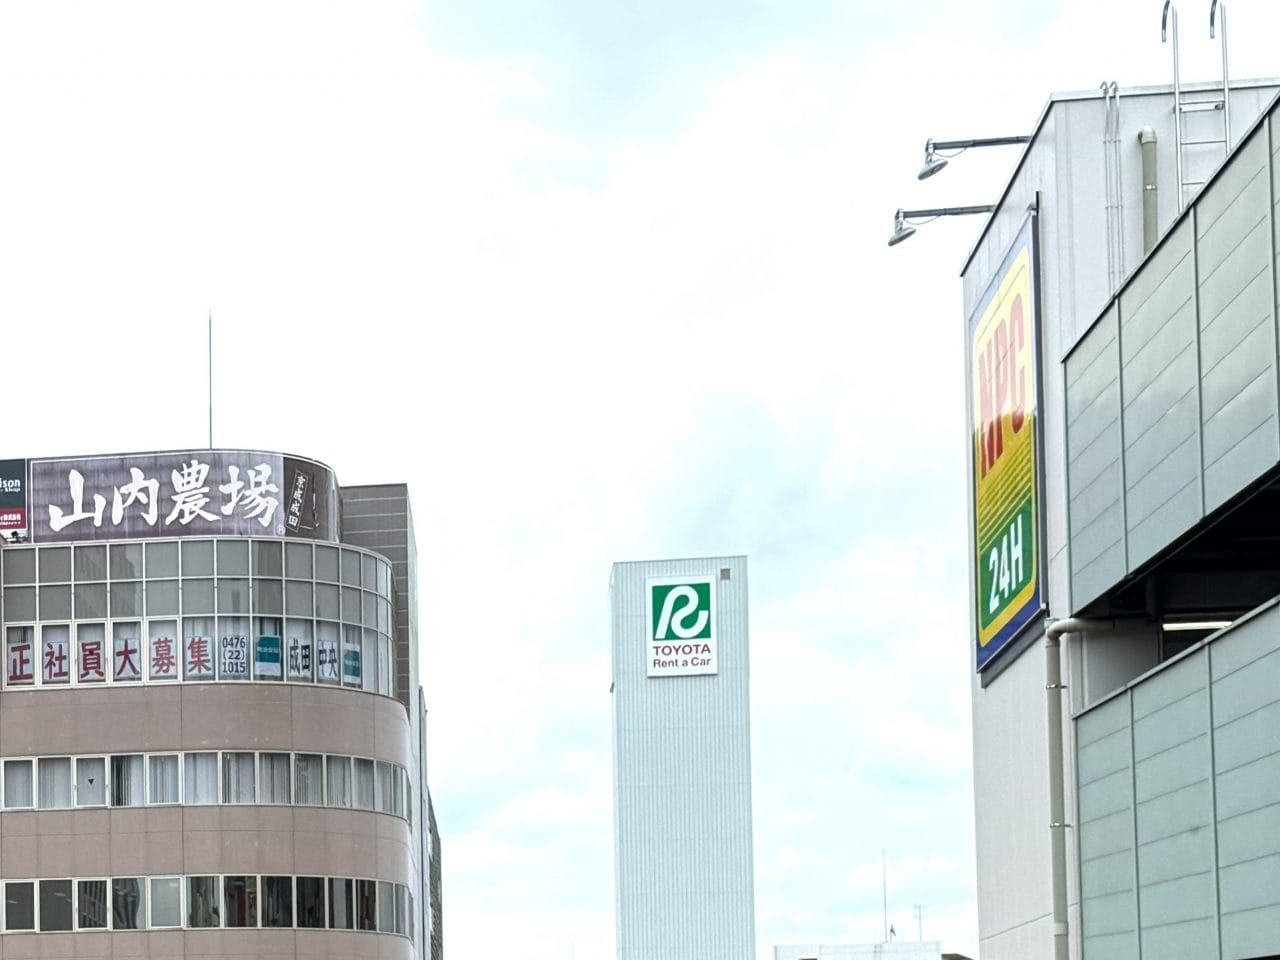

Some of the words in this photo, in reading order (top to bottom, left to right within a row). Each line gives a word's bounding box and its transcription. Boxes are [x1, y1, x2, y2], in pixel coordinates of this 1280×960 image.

[978, 293, 1025, 480] NPC
[49, 459, 281, 532] 山内農場
[988, 514, 1022, 614] 24H
[222, 637, 246, 648] 0476
[223, 650, 246, 661] (22)
[653, 644, 711, 656] TOYOTA
[8, 637, 211, 682] 正社員大募集
[653, 659, 678, 668] Rent
[691, 657, 711, 667] Car
[222, 662, 246, 674] 1015
